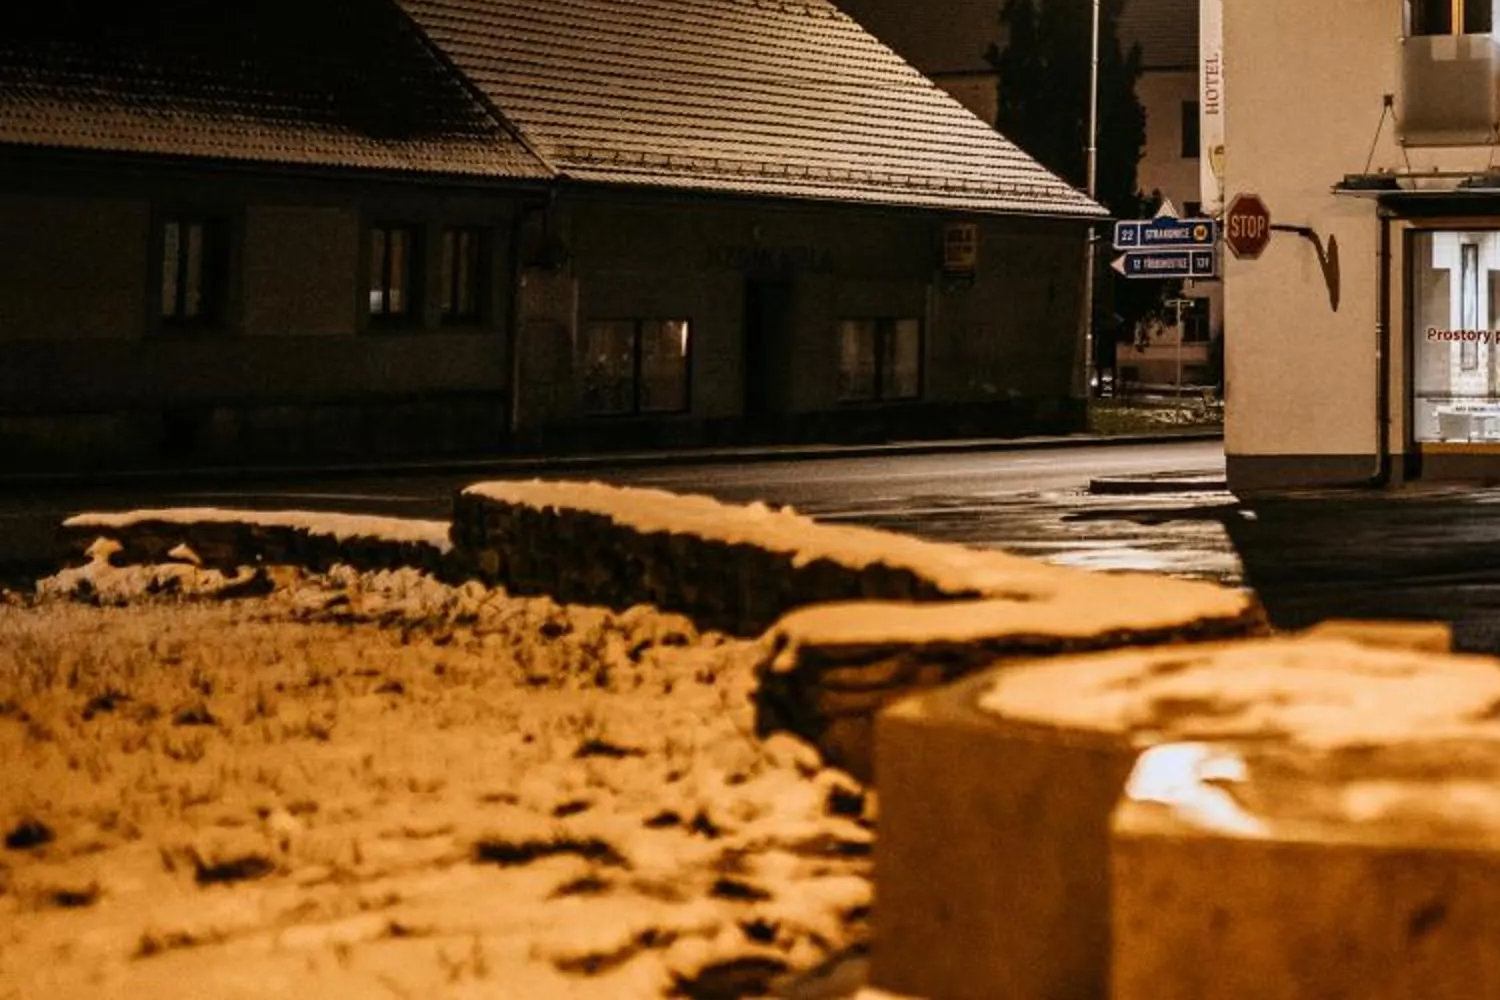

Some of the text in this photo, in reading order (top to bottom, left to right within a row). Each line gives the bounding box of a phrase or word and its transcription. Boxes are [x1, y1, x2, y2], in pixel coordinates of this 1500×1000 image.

[1205, 53, 1219, 116] HOTEL
[1231, 216, 1266, 239] STOP
[1427, 328, 1491, 345] Prostory
